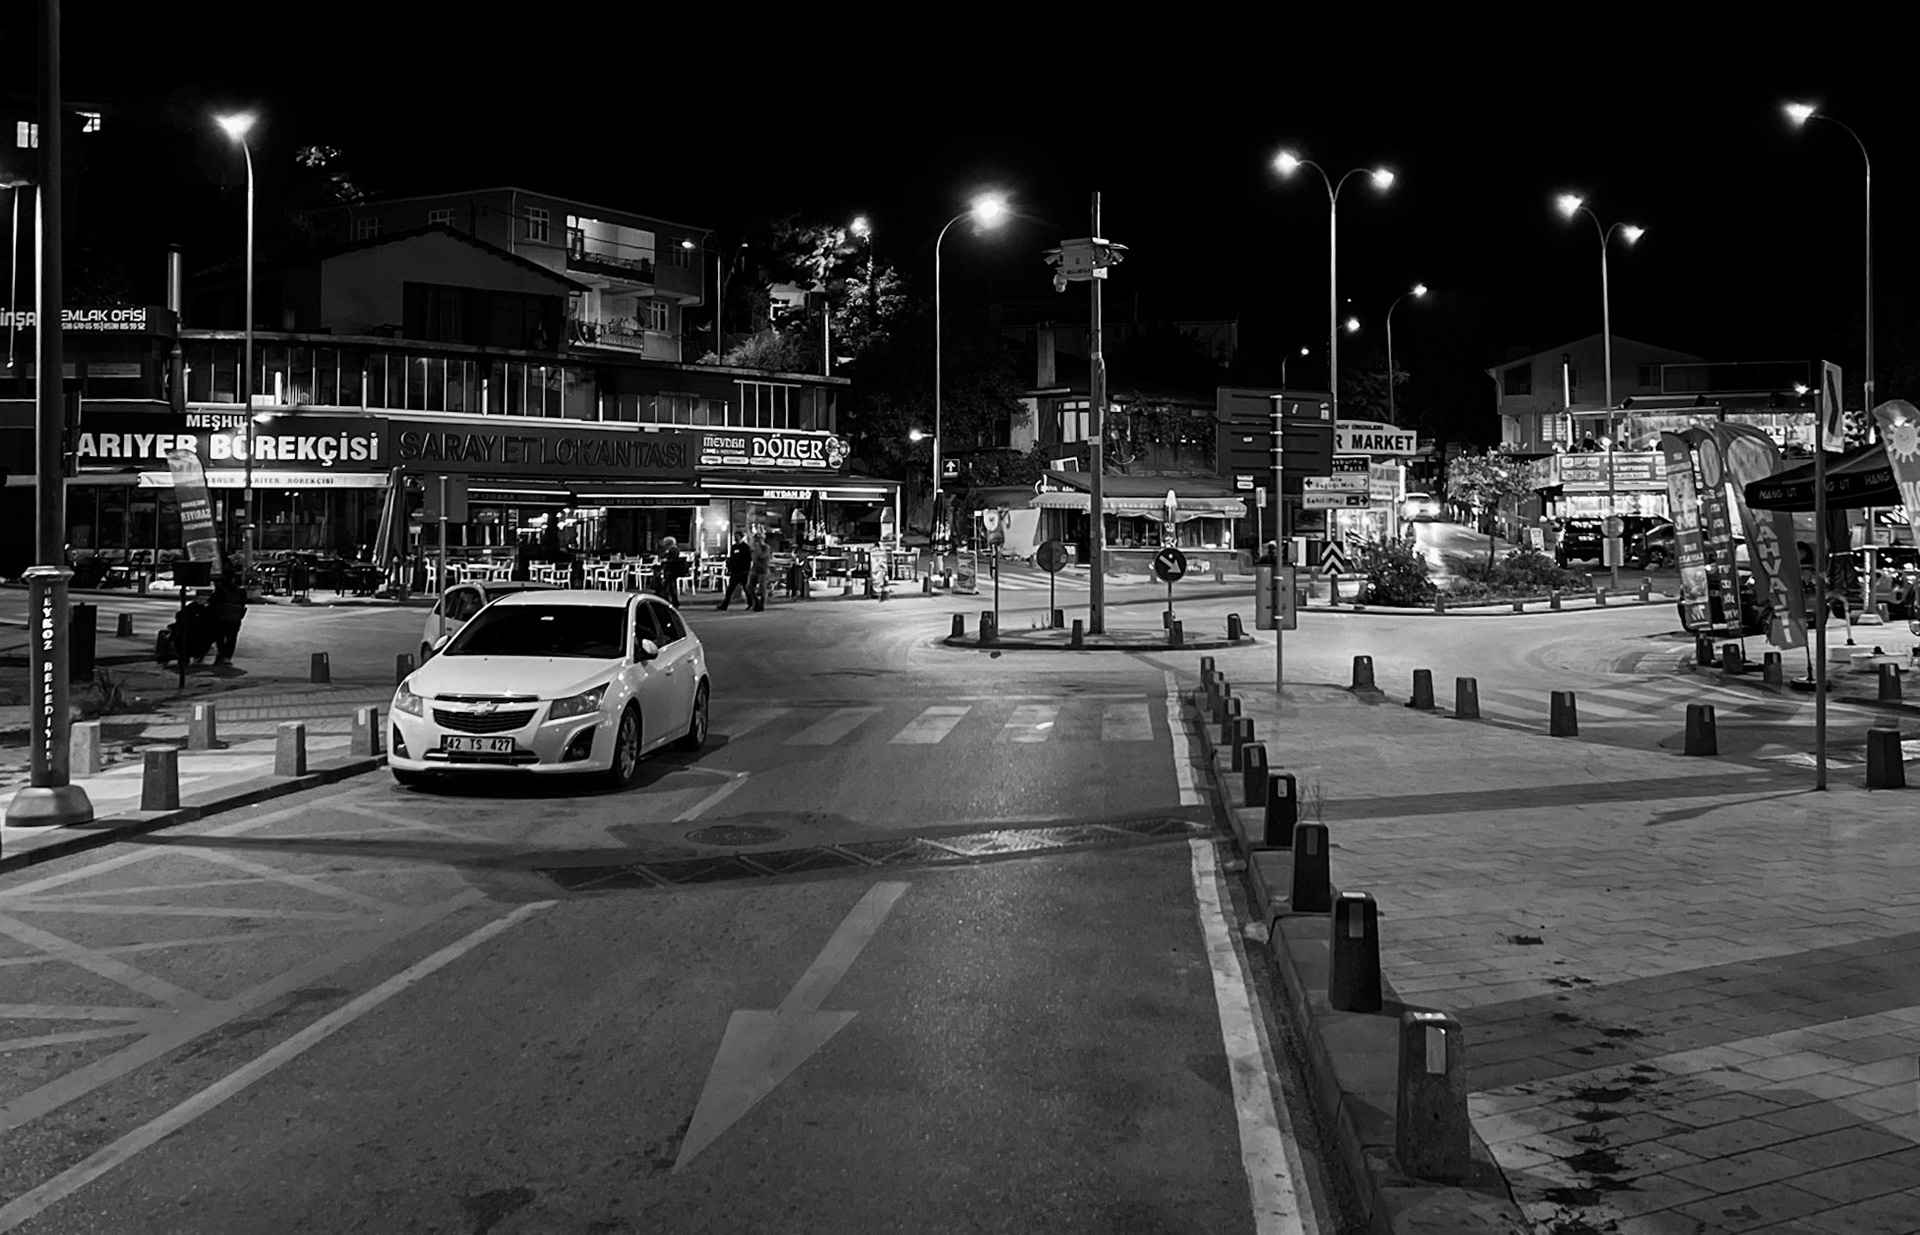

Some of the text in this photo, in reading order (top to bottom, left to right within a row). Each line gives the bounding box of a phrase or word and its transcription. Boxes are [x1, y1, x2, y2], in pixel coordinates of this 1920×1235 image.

[61, 309, 108, 321] EMLAK
[111, 307, 147, 321] OFİSİ
[77, 431, 379, 466] ARIYER BÖREKÇİSİ
[400, 430, 688, 468] SARAY ET LOKANTASI
[752, 433, 823, 459] DÖNER
[1351, 434, 1414, 452] MARKET
[448, 738, 511, 751] 42 TS 427
